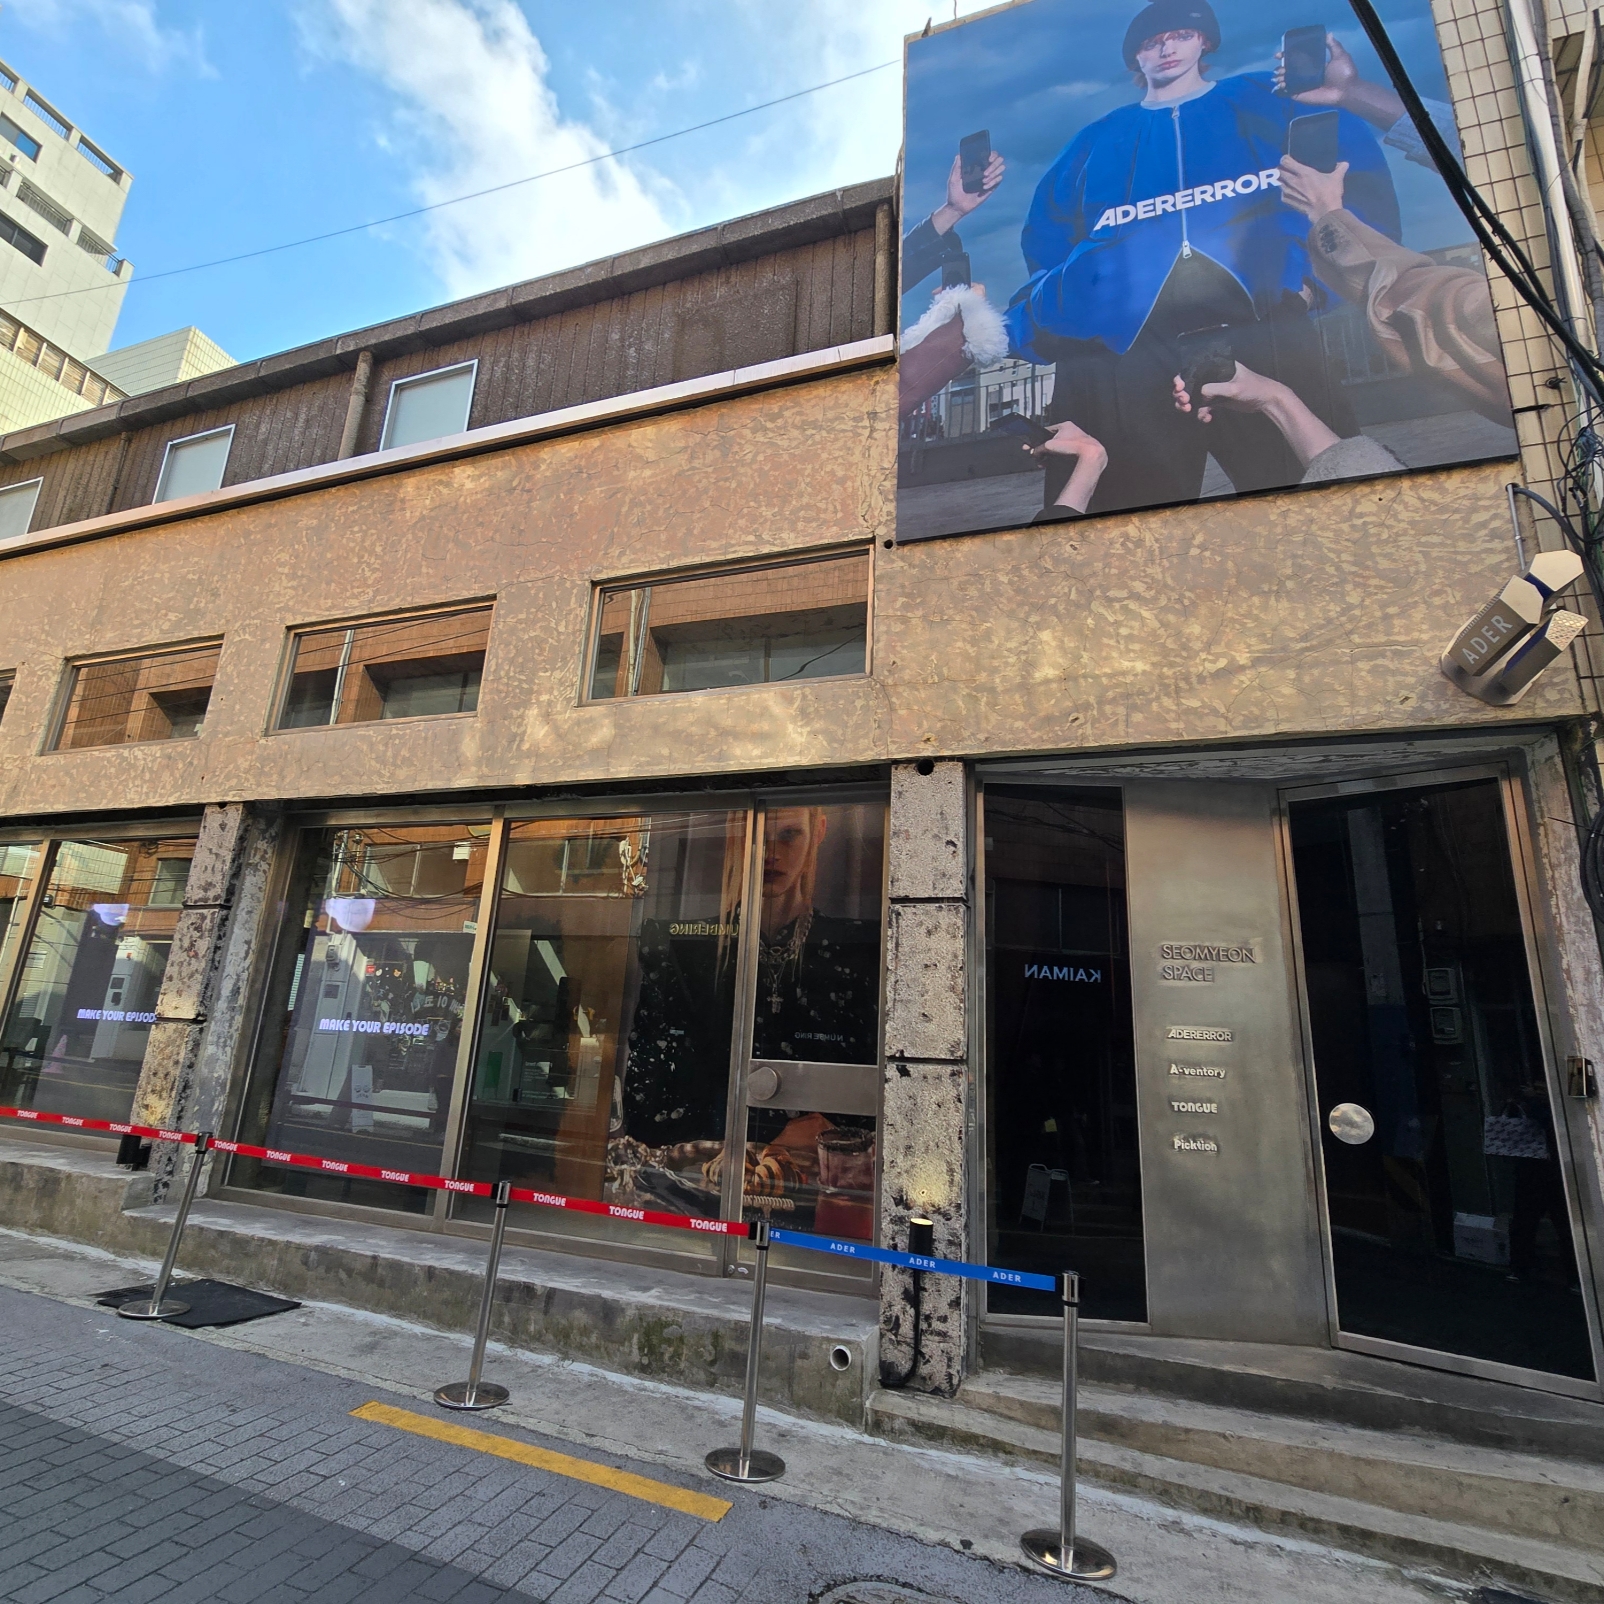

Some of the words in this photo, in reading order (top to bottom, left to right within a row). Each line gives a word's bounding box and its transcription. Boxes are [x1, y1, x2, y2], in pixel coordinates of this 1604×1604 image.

[1093, 167, 1282, 231] ADERERROR
[1461, 614, 1514, 665] ADER
[1161, 944, 1256, 963] SEOMYEON
[1162, 966, 1214, 982] SPACE
[77, 1008, 101, 1020] MAKE
[102, 1010, 124, 1021] YOUR
[125, 1011, 157, 1023] EPISOD
[319, 1018, 351, 1031] MAKE
[352, 1020, 381, 1033] YOUR
[382, 1021, 429, 1036] EPISODE
[1167, 1029, 1232, 1041] ADERERROR
[1169, 1063, 1226, 1079] A-ventory
[1171, 1101, 1218, 1114] TONGUE
[17, 1110, 39, 1119] TONGUE
[62, 1116, 84, 1126] TONGUE
[109, 1123, 132, 1133] TONGUE
[158, 1130, 182, 1141] TONGUE
[214, 1140, 238, 1152] TONGUE
[266, 1150, 291, 1162] TONGUE
[322, 1160, 348, 1172] TONGUE
[381, 1170, 410, 1183] TONGUE
[444, 1180, 474, 1192] TONGUE
[533, 1192, 567, 1207] TONGUE
[609, 1205, 645, 1220] TONGUE
[690, 1218, 728, 1233] TONGUE
[770, 1230, 781, 1239] ER
[830, 1242, 856, 1254] ADER
[909, 1257, 936, 1269] ADER
[992, 1270, 1021, 1283] ADER
